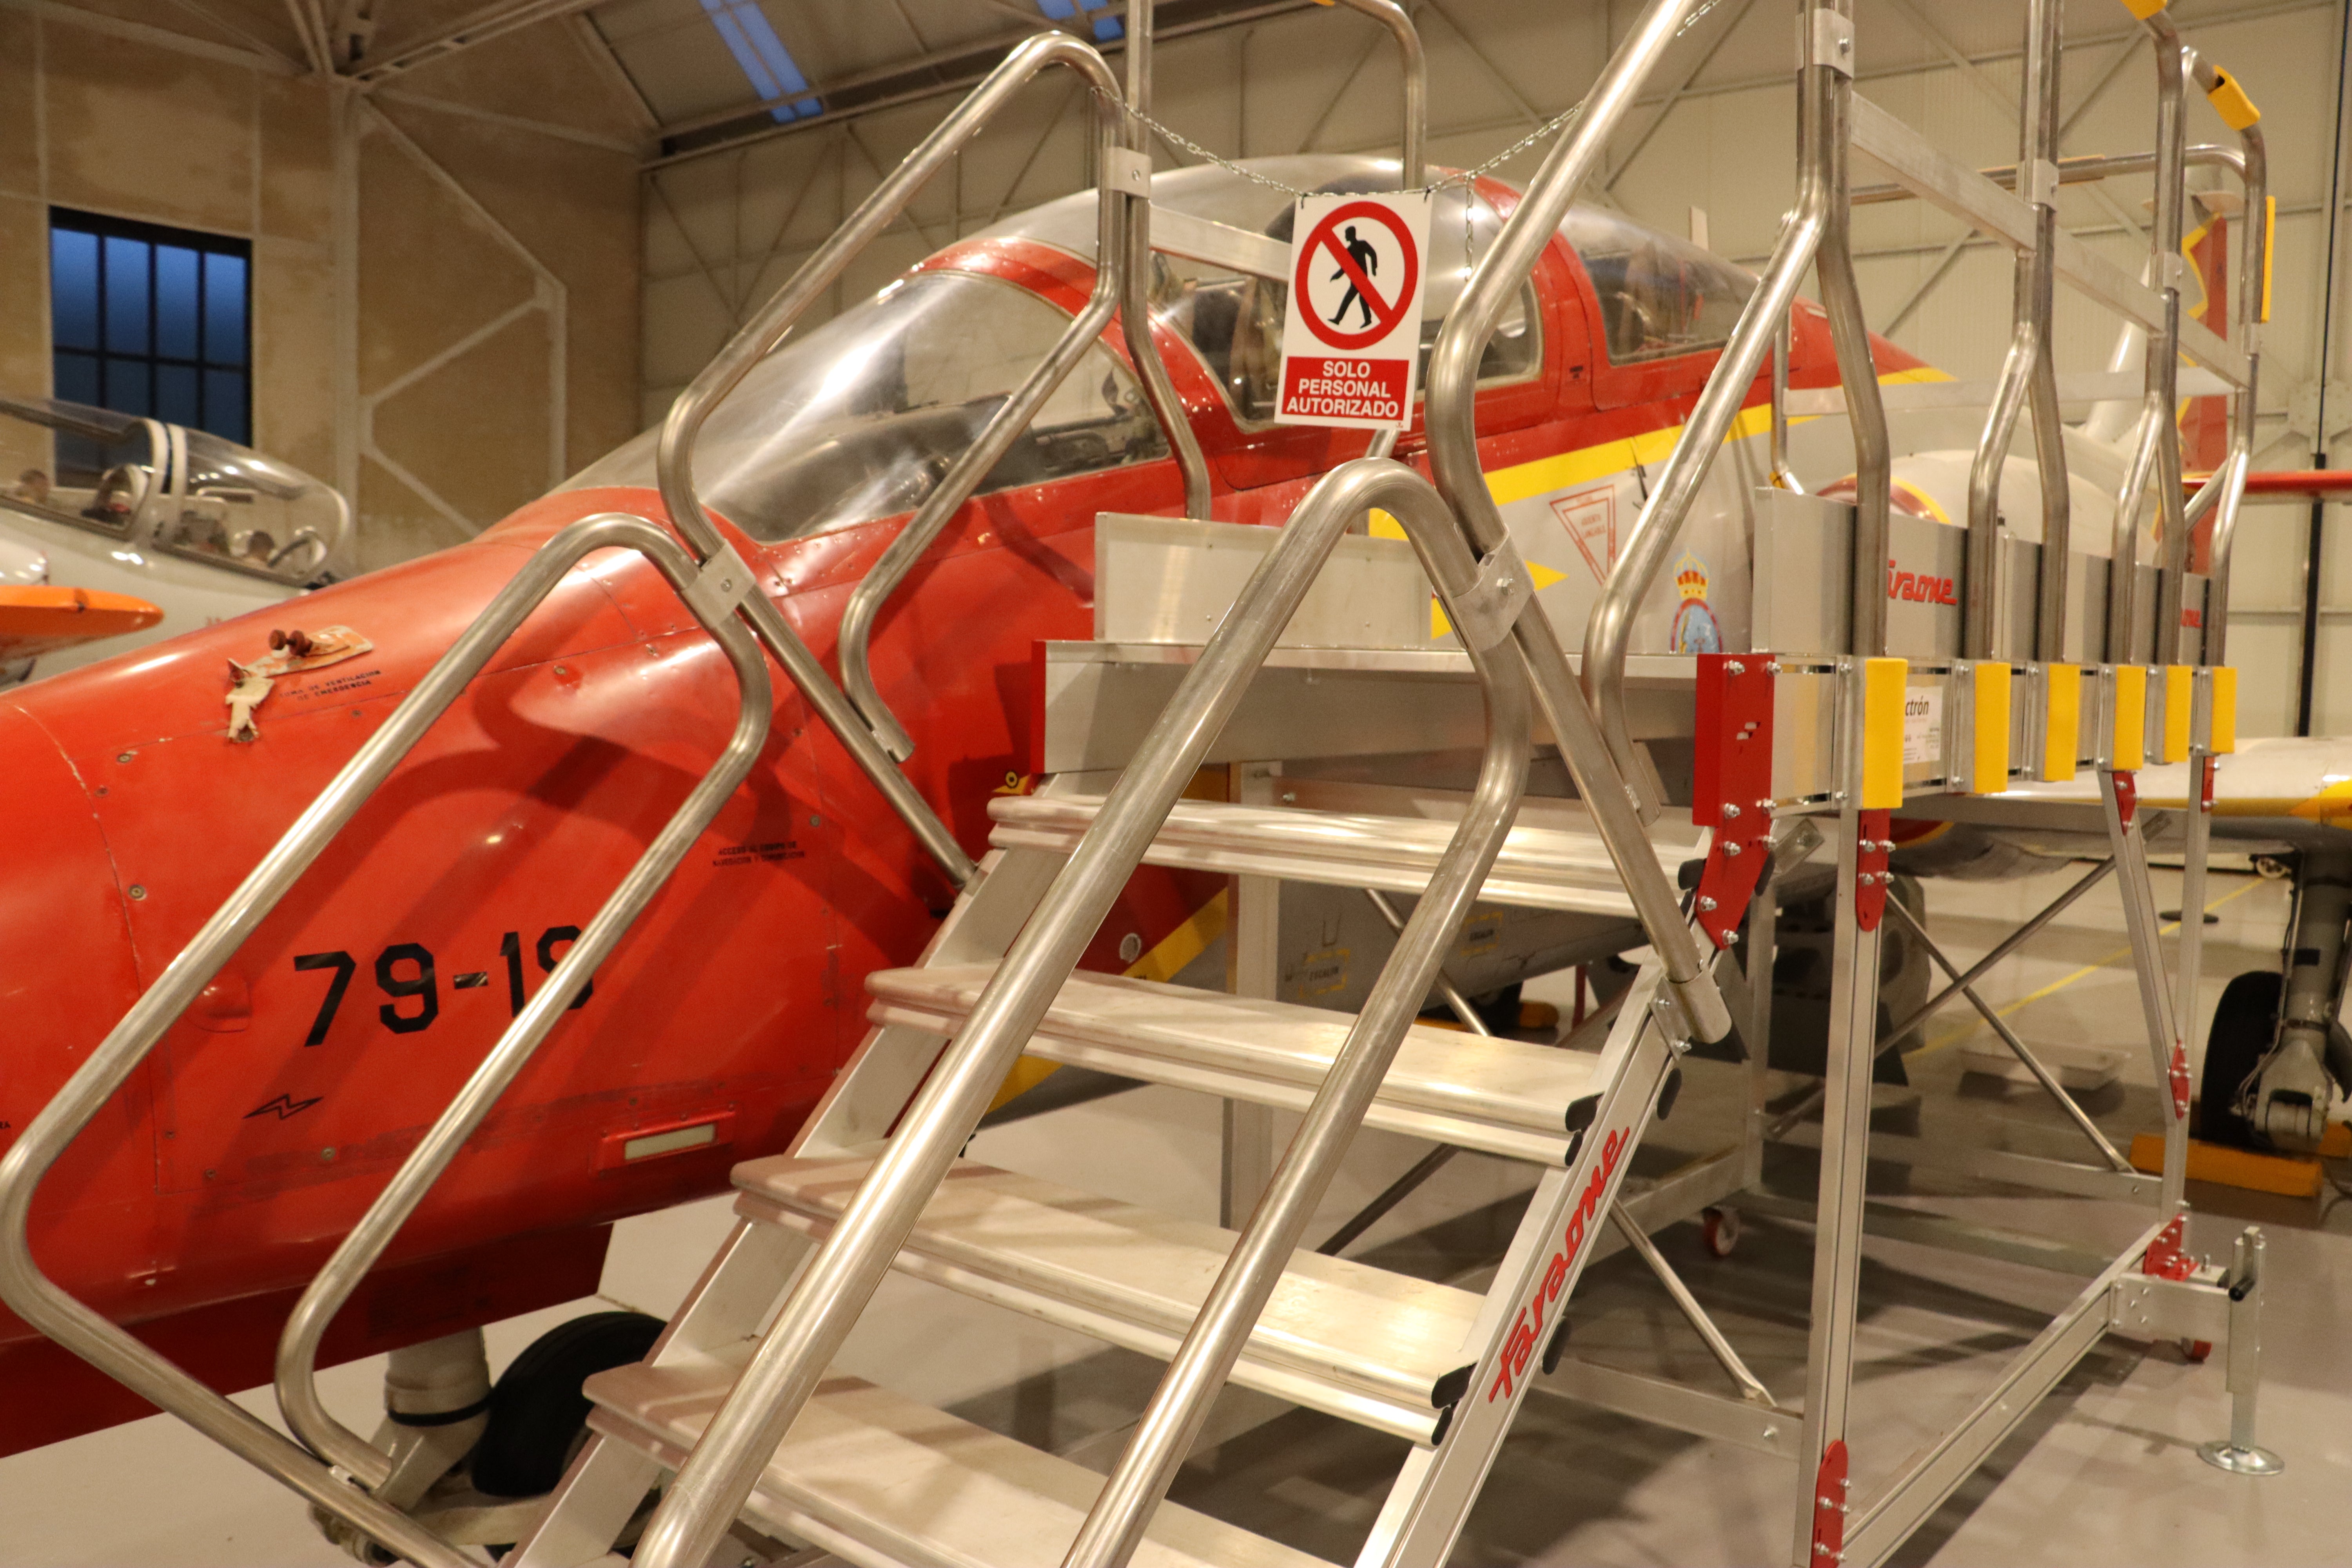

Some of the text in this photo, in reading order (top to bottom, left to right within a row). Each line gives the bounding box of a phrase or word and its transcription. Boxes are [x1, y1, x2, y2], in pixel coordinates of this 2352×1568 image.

[1322, 360, 1370, 378] SOLO
[1298, 378, 1391, 397] PERSONAL
[1286, 396, 1399, 417] AUTORIZADO
[315, 680, 371, 697] EMERGENCIA
